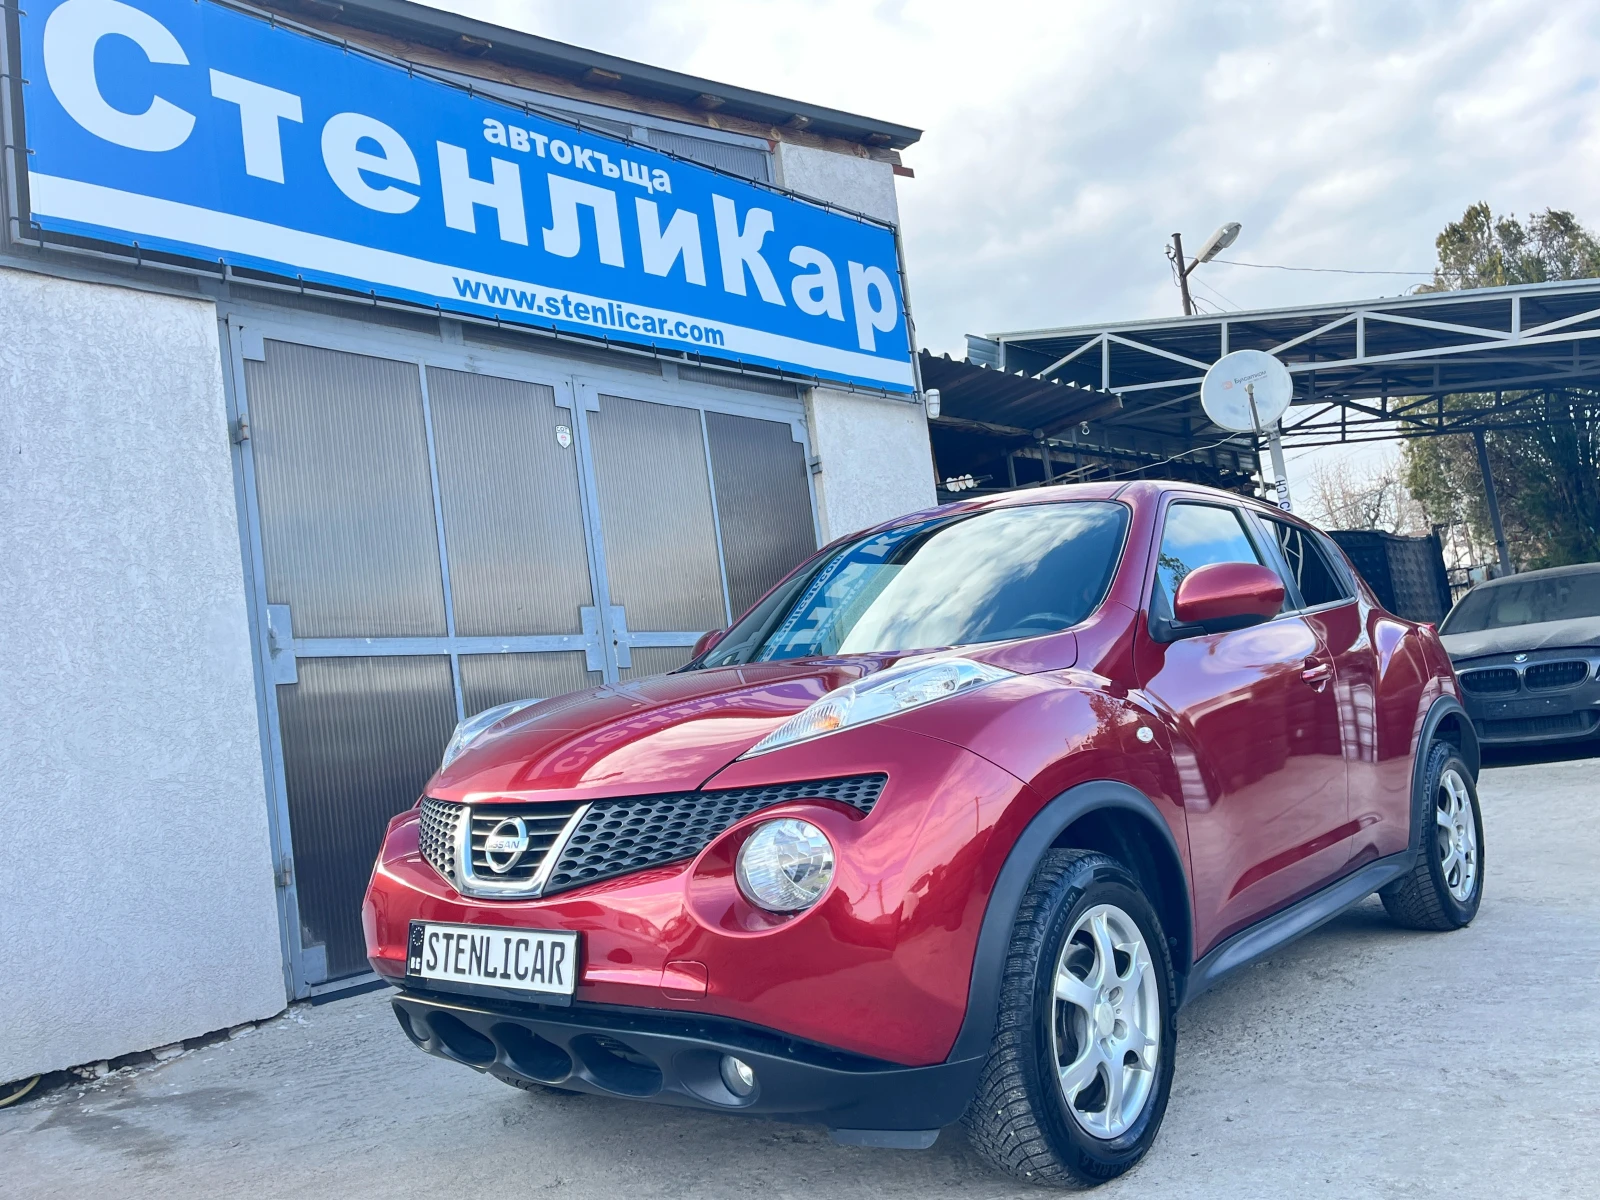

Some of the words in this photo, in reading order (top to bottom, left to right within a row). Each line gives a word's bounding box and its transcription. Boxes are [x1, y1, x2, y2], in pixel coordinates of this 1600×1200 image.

[43, 0, 898, 352] СтенлиКар
[483, 117, 672, 195] автокъща
[452, 276, 725, 347] www.stenlicar.com
[410, 957, 421, 970] BG
[426, 932, 566, 985] STENLICAR
